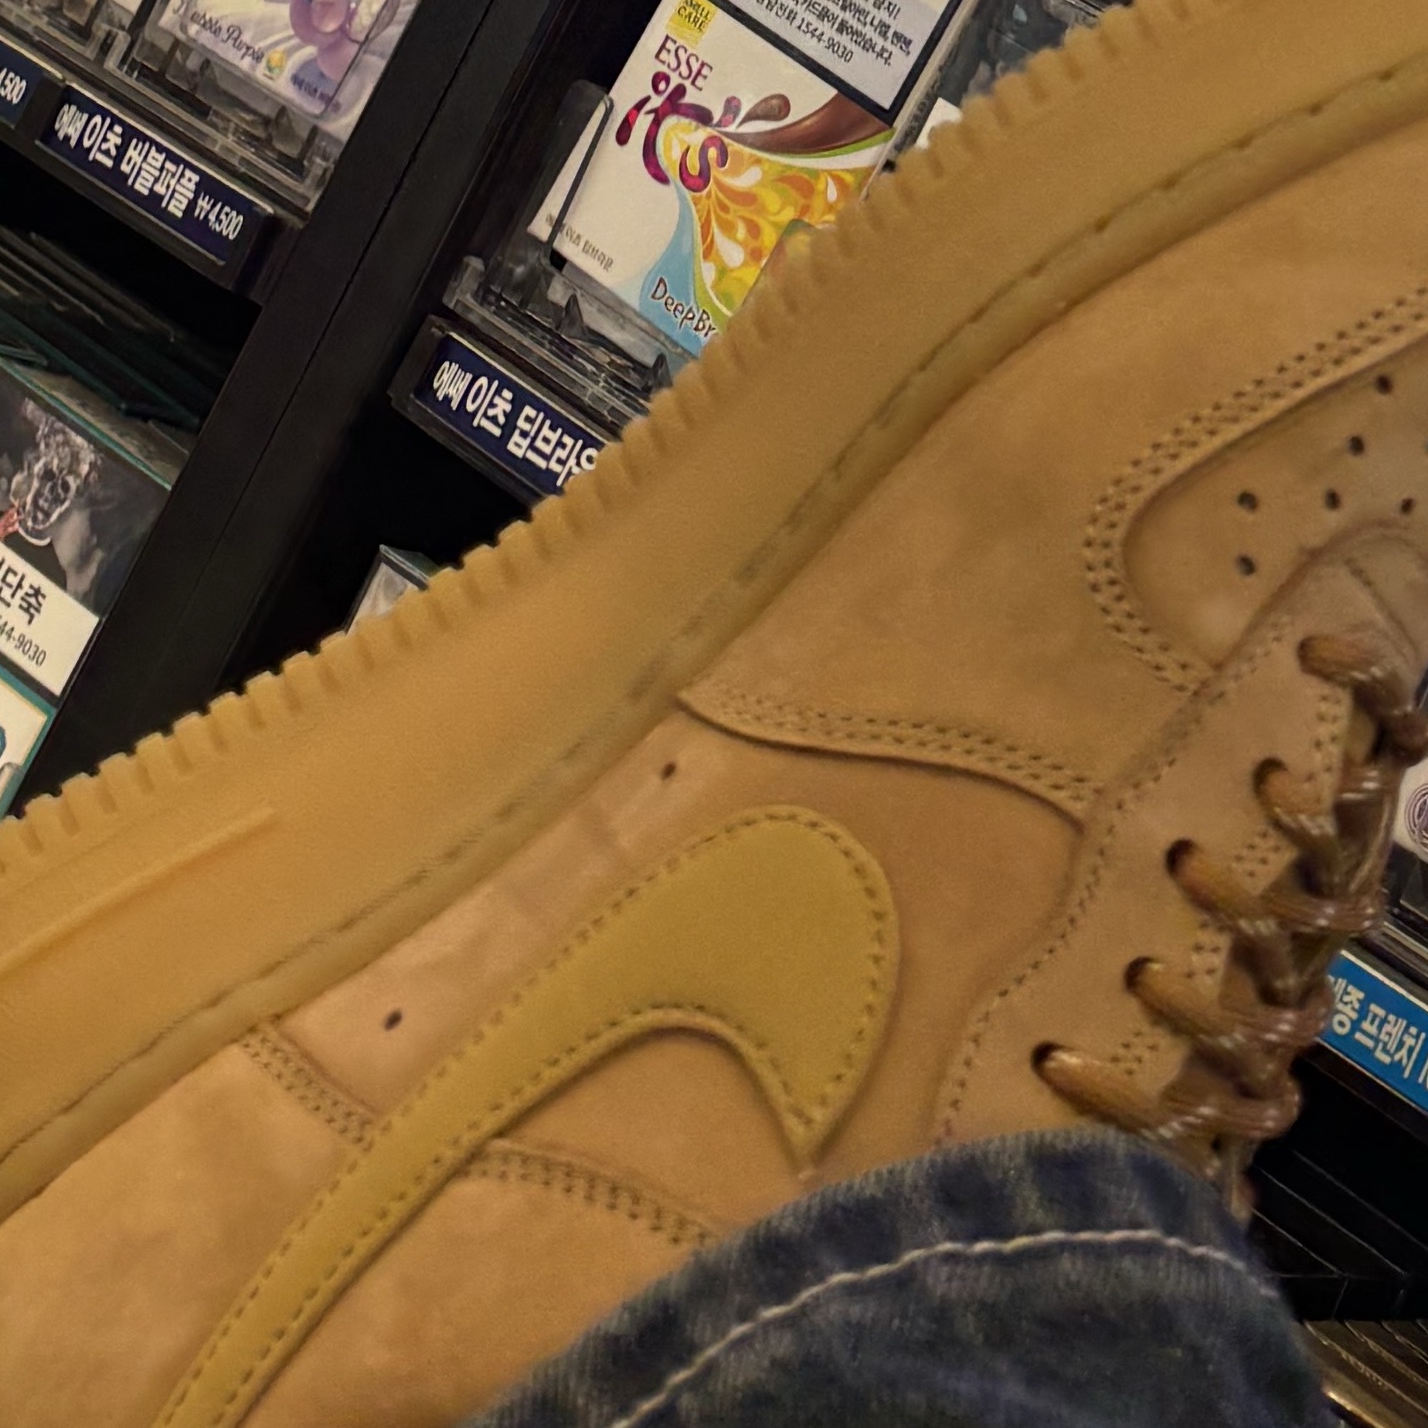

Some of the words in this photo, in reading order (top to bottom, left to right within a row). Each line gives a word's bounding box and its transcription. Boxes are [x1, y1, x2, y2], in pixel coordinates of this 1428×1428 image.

[653, 34, 715, 92] ESSE
[55, 100, 88, 144] 에쎄
[84, 111, 126, 169] 이츠
[119, 130, 205, 220] 버블퍼플
[193, 193, 244, 243] ₩4,500
[1356, 996, 1427, 1088] 프렌치
